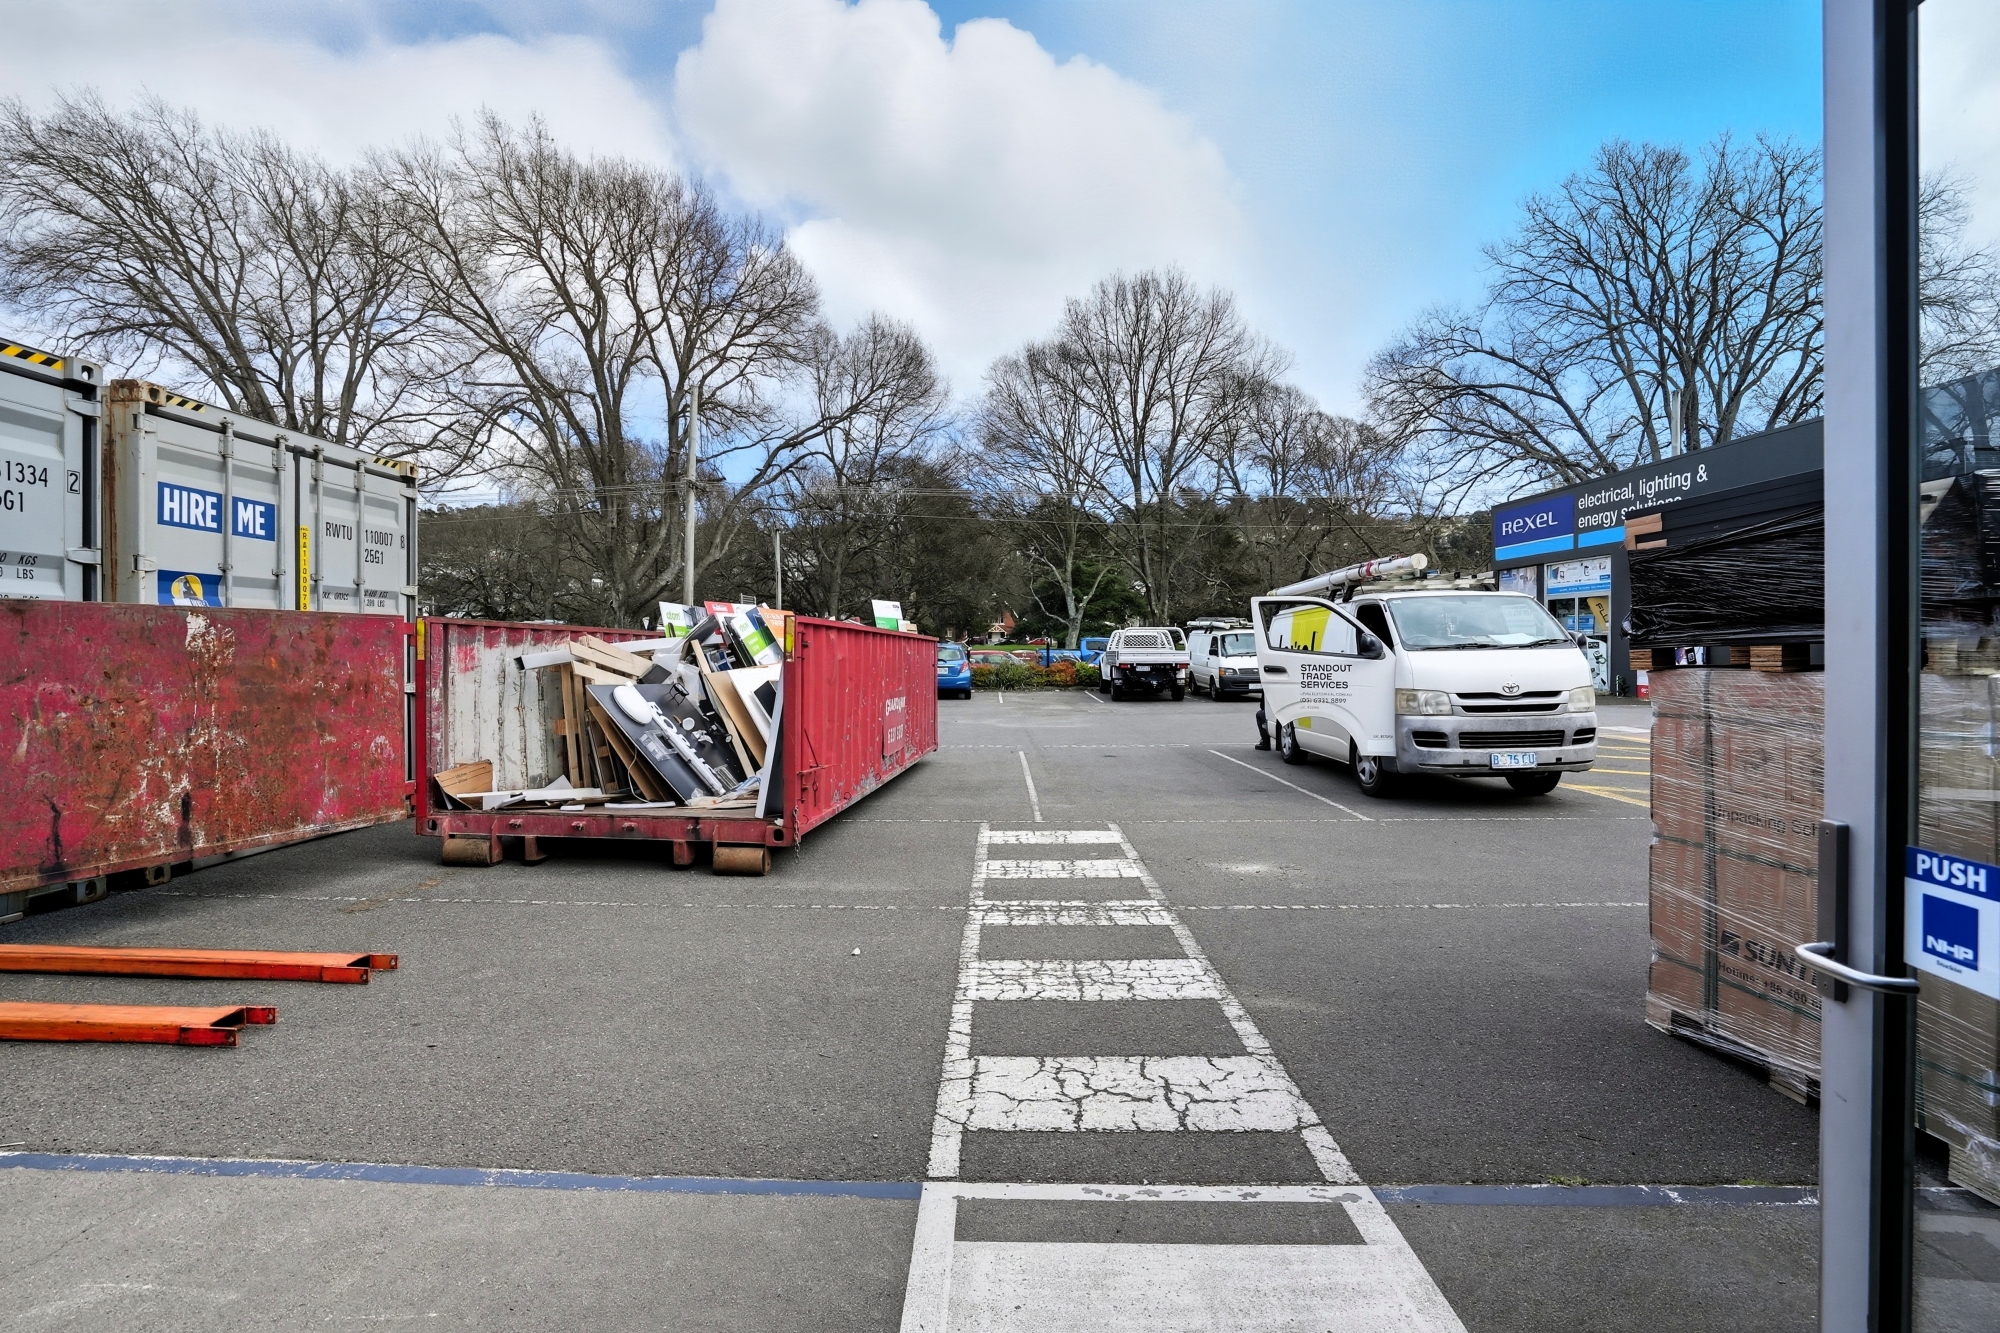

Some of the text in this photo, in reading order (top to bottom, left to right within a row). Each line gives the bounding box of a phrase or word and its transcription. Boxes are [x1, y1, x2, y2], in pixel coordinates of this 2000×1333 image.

[1578, 463, 1709, 510] electrical, lighting &
[163, 486, 266, 536] HIRE ME
[1578, 510, 1619, 532] energy
[325, 521, 353, 541] RWTU
[18, 554, 38, 566] KGS
[16, 568, 34, 580] LBS
[1300, 664, 1353, 672] STANDOUT
[1301, 672, 1333, 680] TRADE
[1300, 681, 1349, 689] SERVICES
[1916, 852, 1988, 893] PUSH
[1926, 934, 1974, 961] NHP
